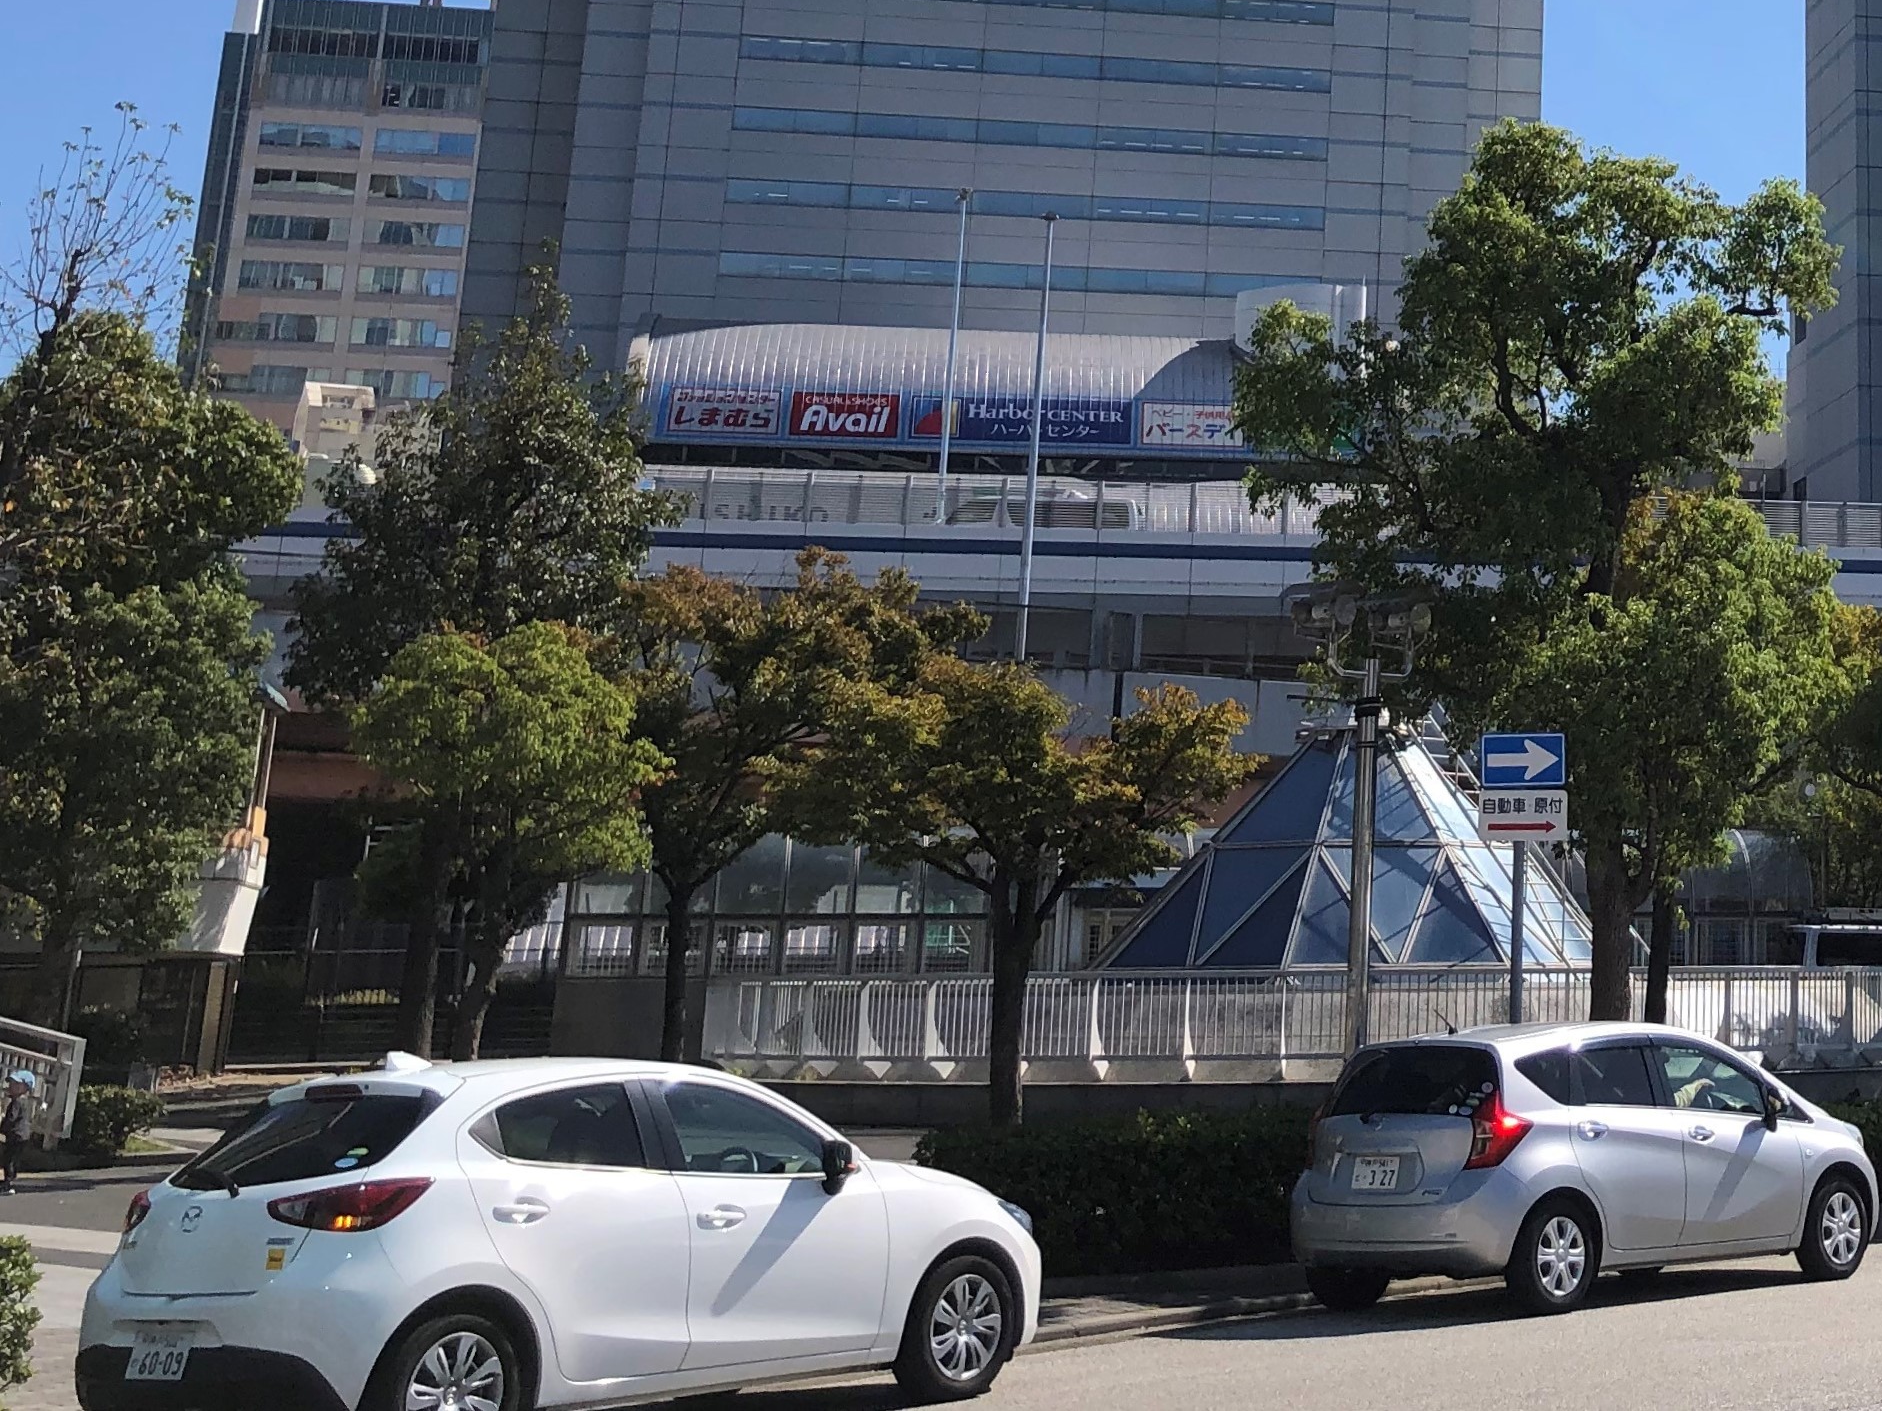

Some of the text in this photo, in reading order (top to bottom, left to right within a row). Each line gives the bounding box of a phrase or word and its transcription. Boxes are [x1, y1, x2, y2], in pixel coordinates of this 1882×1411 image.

[674, 405, 774, 428] しまむら
[801, 405, 890, 433] Avail
